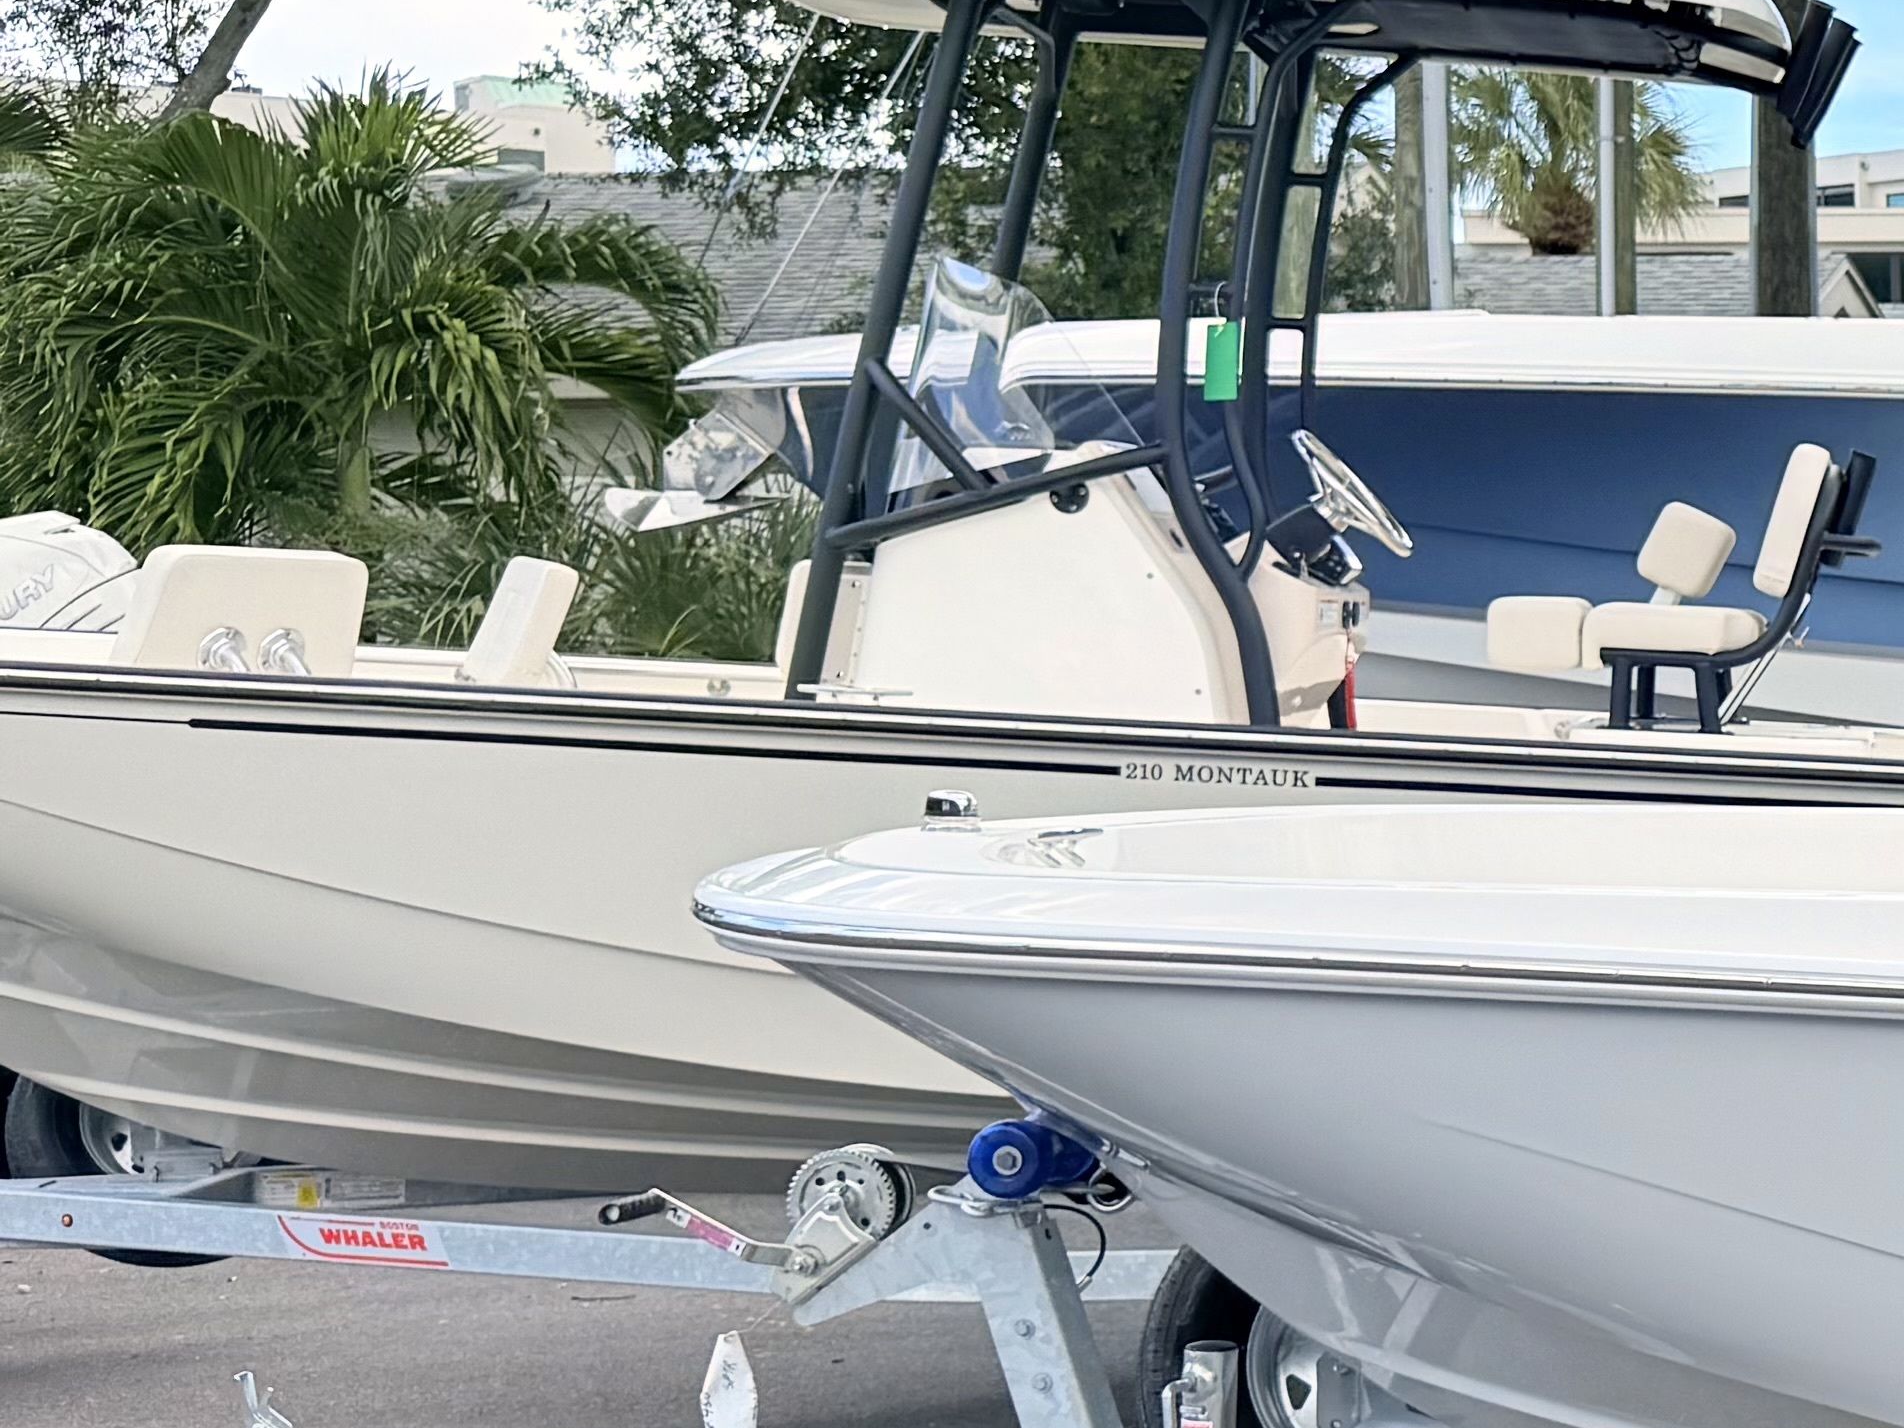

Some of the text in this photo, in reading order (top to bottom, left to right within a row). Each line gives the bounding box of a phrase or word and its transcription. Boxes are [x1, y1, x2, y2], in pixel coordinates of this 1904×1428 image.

[1125, 762, 1310, 788] 210 MONTAUK
[319, 1228, 428, 1252] WHALER
